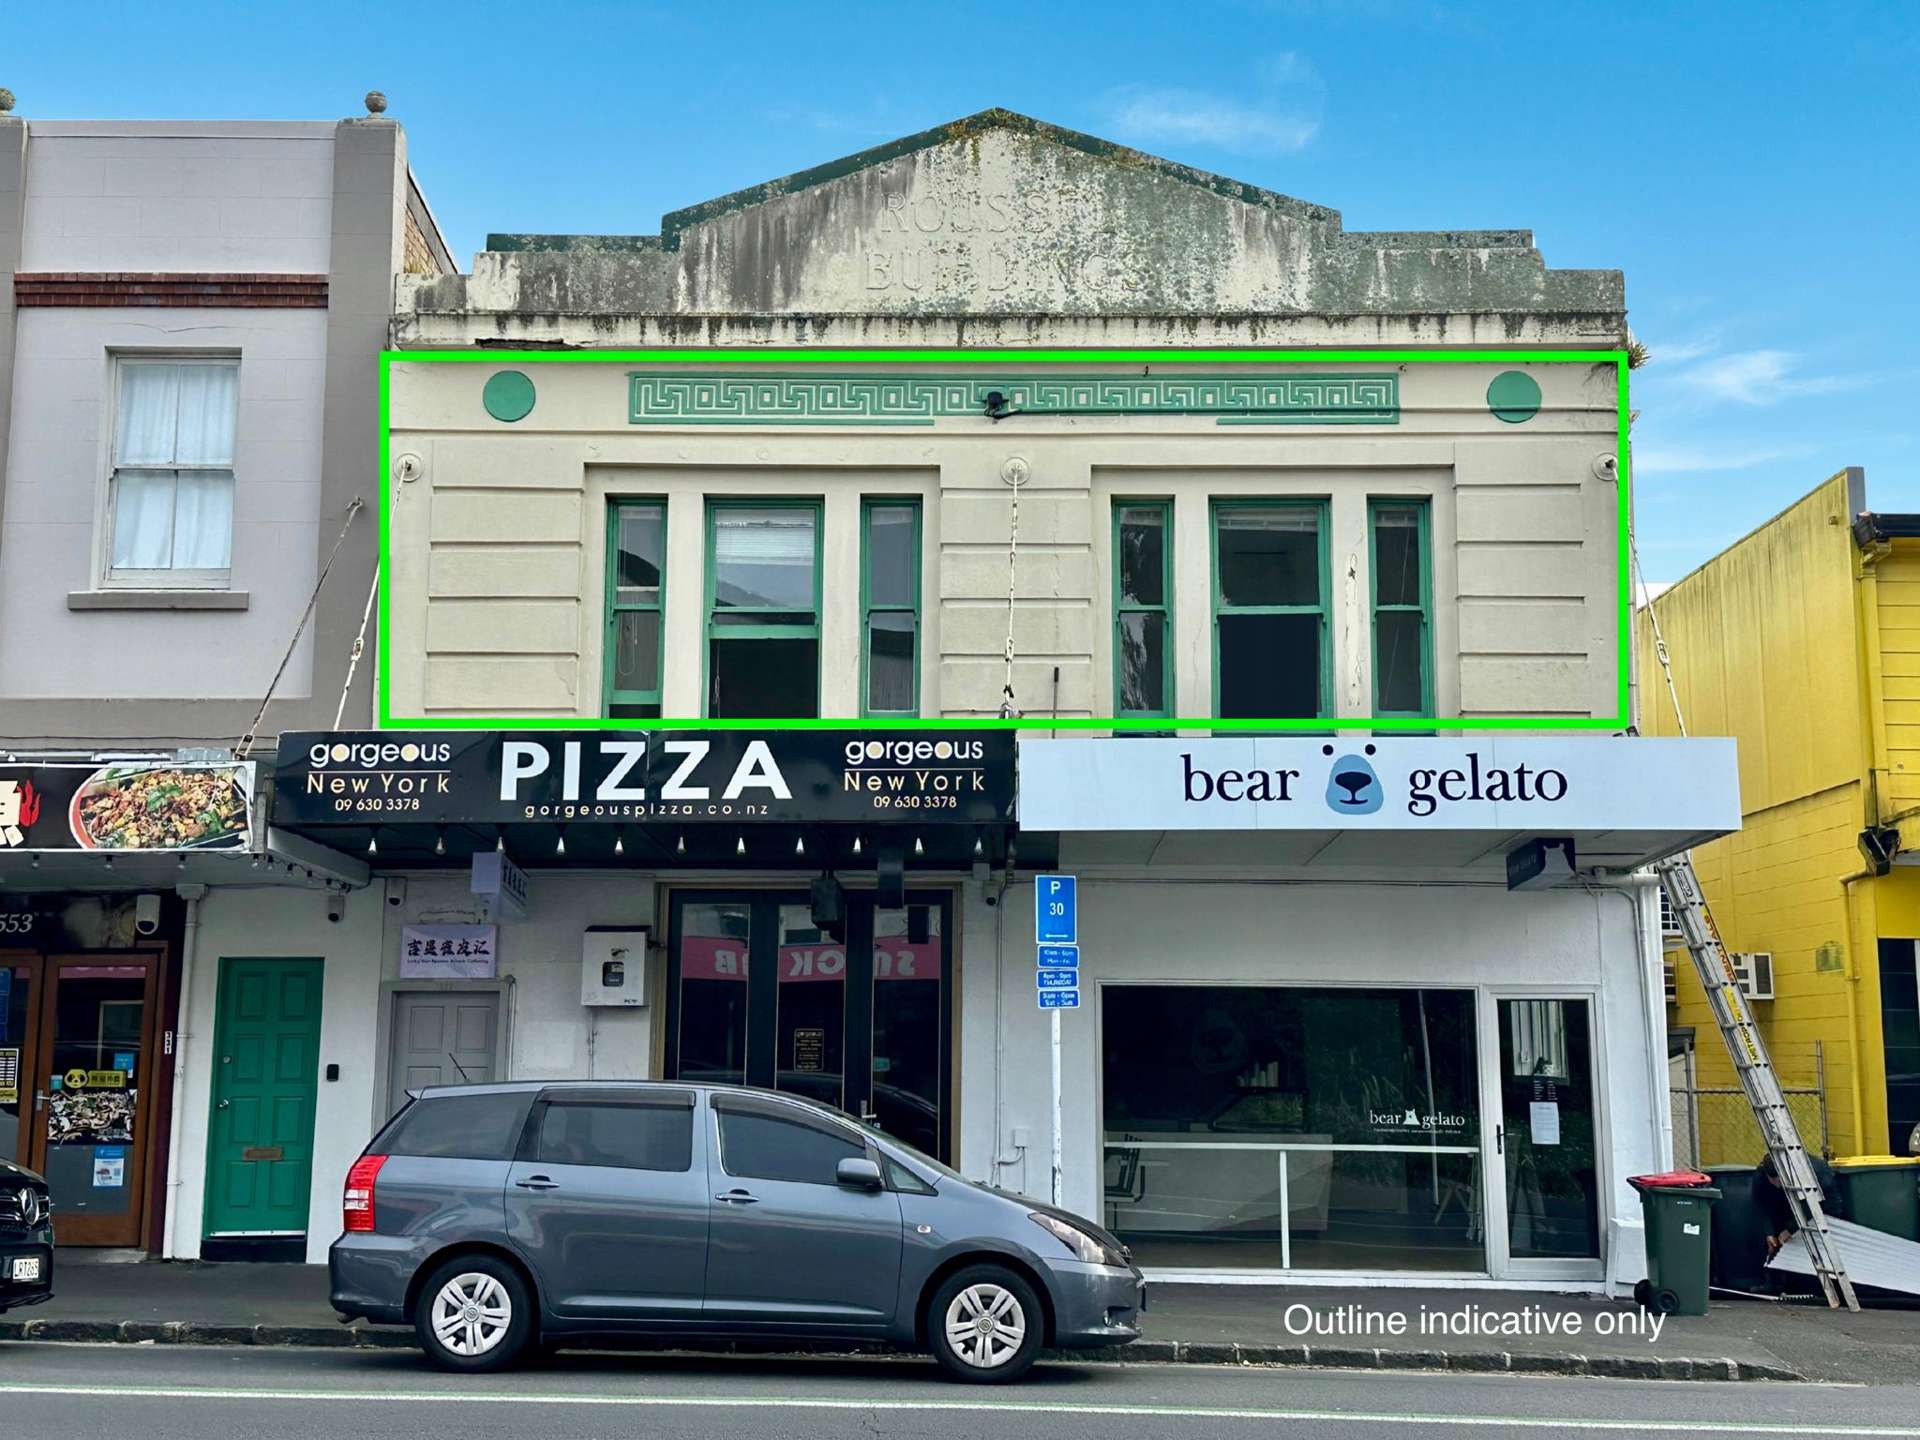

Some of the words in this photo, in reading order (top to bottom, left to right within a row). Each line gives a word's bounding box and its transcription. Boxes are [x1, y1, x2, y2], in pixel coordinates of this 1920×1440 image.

[309, 743, 451, 769] gorgeous
[845, 741, 984, 766] gorgeous
[500, 740, 793, 801] PIZZA
[307, 773, 370, 794] New
[380, 773, 450, 794] York
[844, 771, 905, 792] New
[915, 770, 985, 792] York
[1180, 753, 1300, 802] bear
[1407, 752, 1568, 817] gelato
[334, 799, 353, 811] 09
[356, 799, 383, 811] 630
[386, 798, 420, 811] 3378
[524, 802, 768, 819] gorgeouspizza.co.nz
[873, 796, 891, 808] 09
[894, 796, 920, 808] 630
[923, 796, 957, 808] 3378
[1050, 880, 1061, 895] P
[1049, 902, 1064, 916] 30
[1369, 1109, 1401, 1124] bear
[1422, 1111, 1465, 1129] gelato
